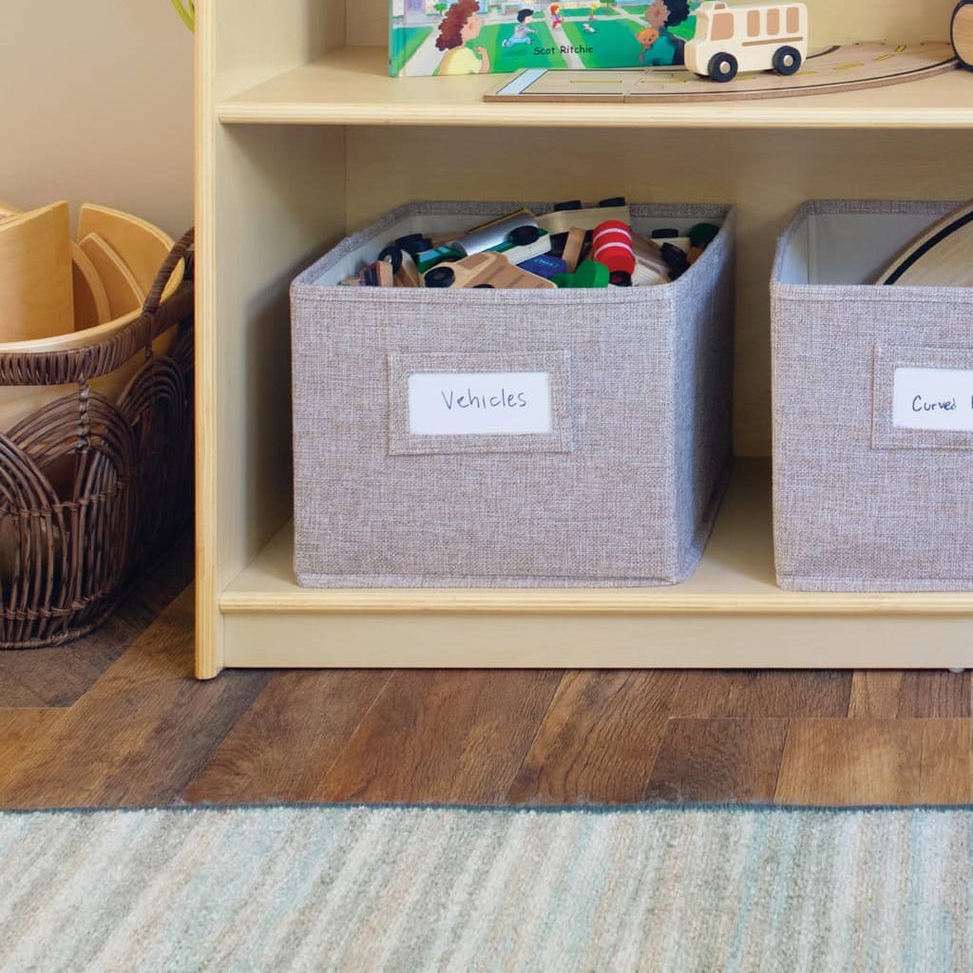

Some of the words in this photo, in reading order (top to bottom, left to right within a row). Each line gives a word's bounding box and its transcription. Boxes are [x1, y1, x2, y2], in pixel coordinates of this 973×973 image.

[533, 47, 555, 56] Scot
[560, 45, 595, 55] Ritchie
[441, 388, 528, 411] Vehicles
[912, 394, 957, 412] Curved
